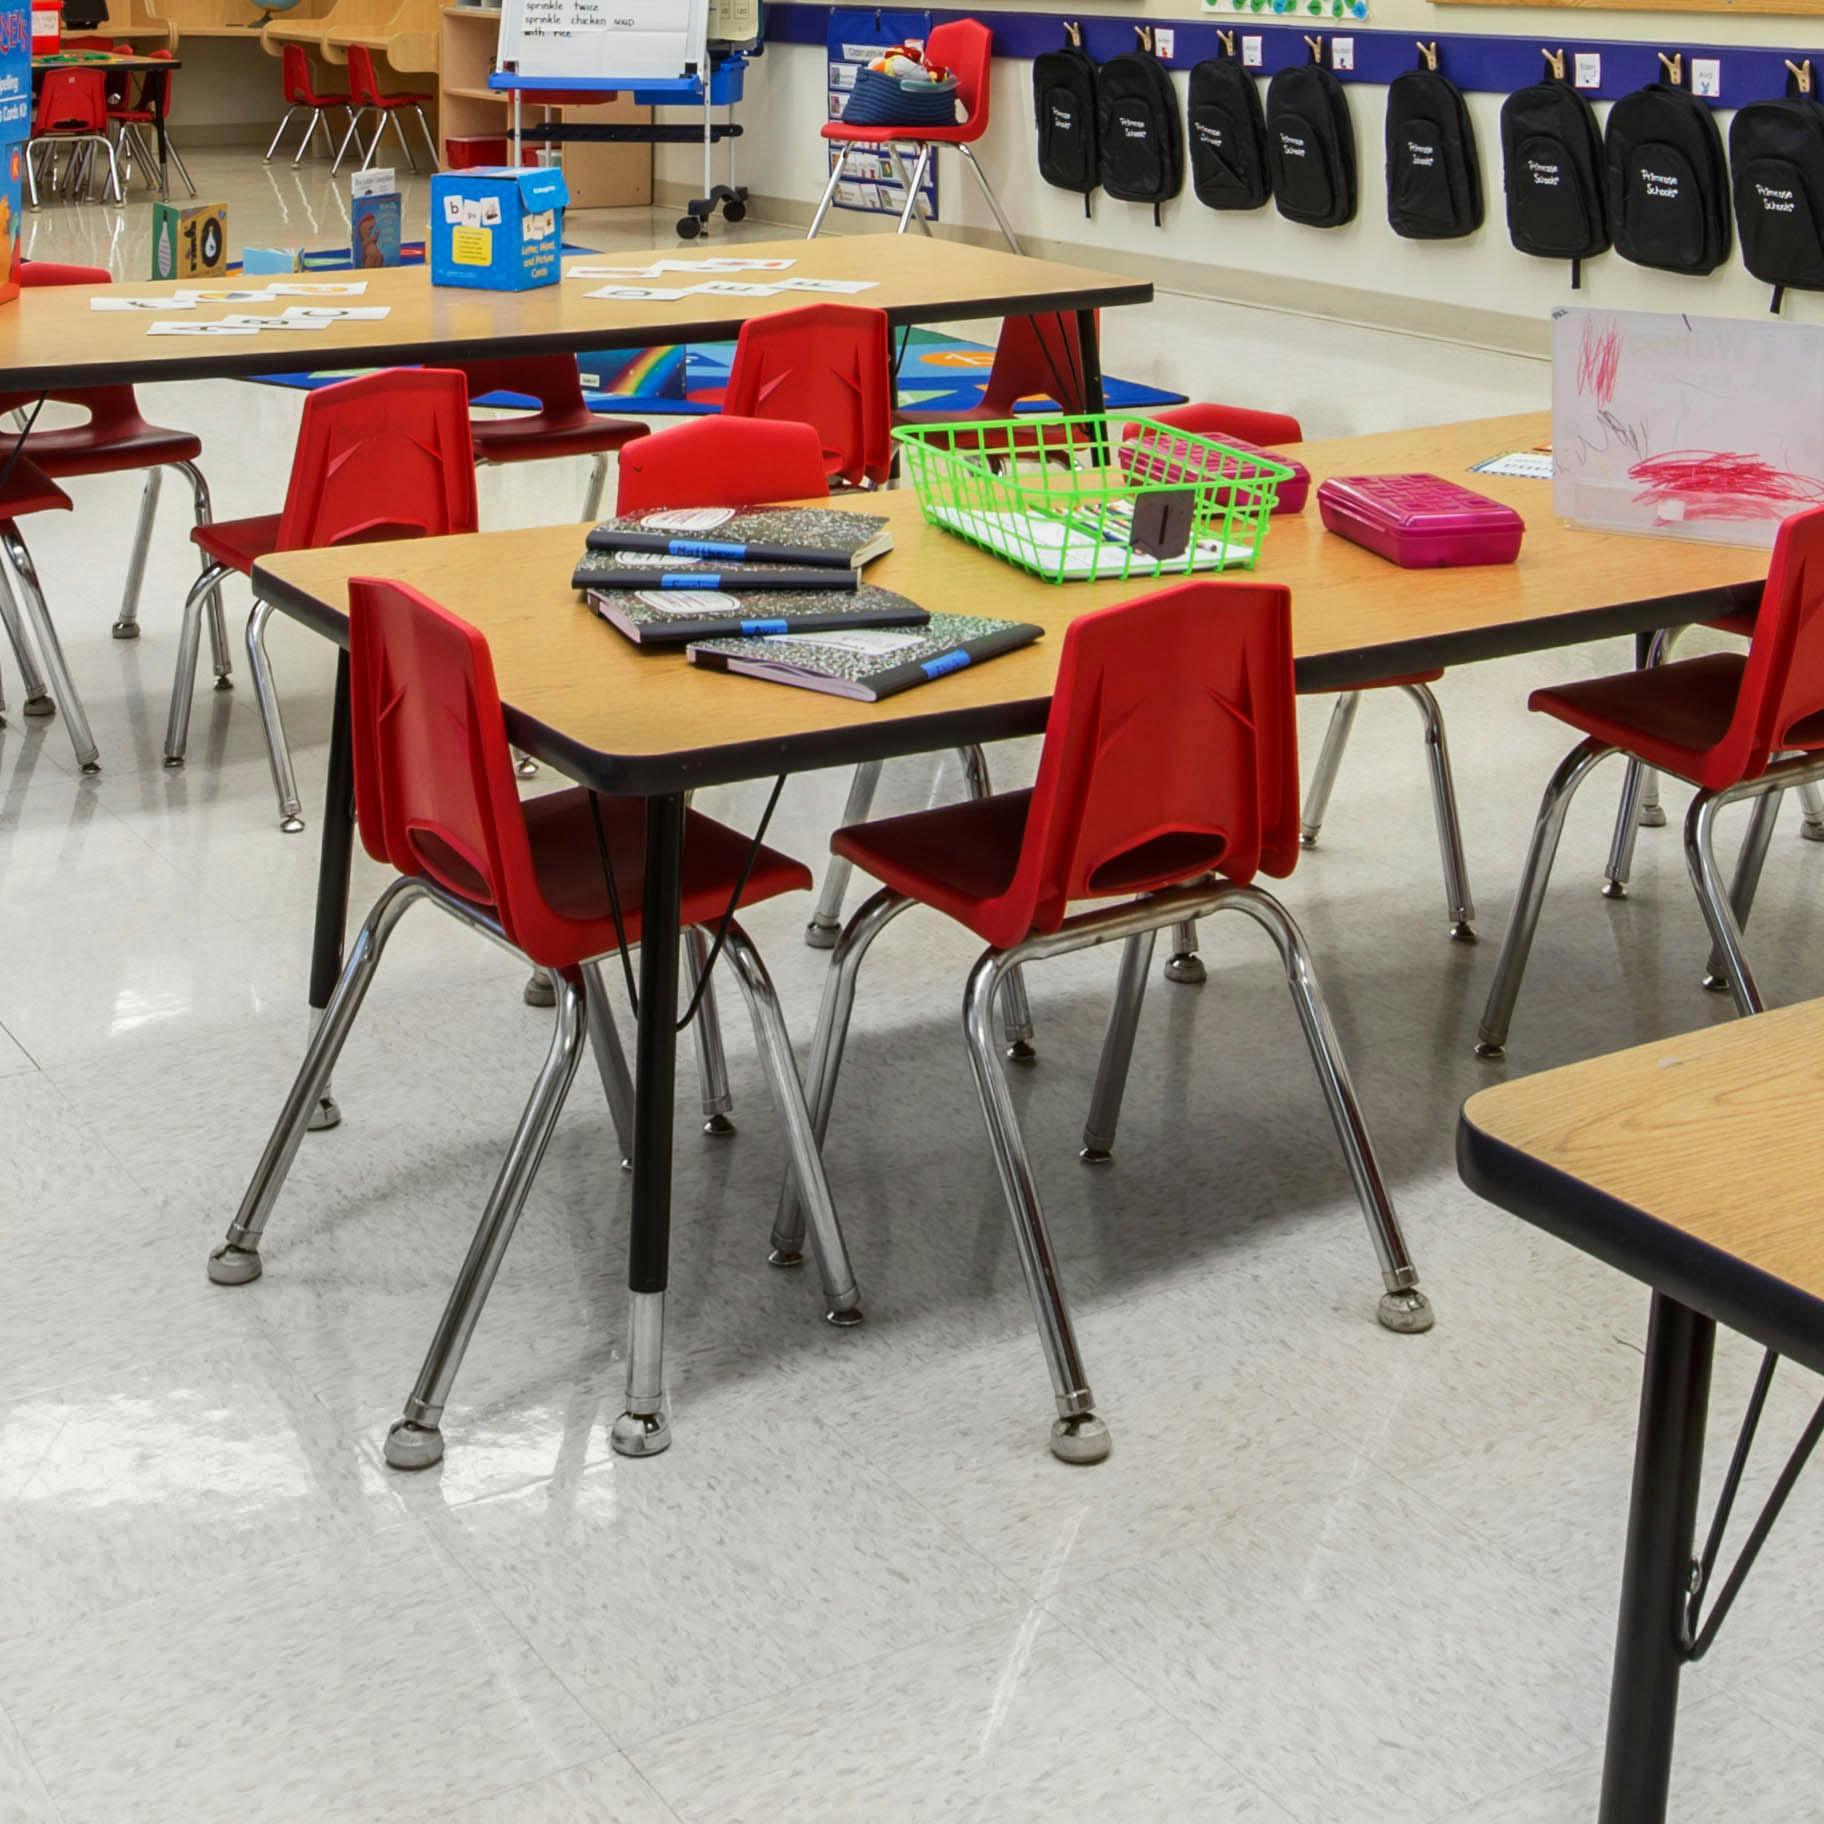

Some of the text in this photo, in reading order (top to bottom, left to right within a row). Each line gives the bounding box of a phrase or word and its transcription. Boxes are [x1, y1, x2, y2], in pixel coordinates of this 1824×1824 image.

[525, 0, 600, 12] sprinkle twice
[525, 13, 635, 27] sprinkle chicken soup
[524, 28, 545, 38] with
[449, 200, 459, 215] b
